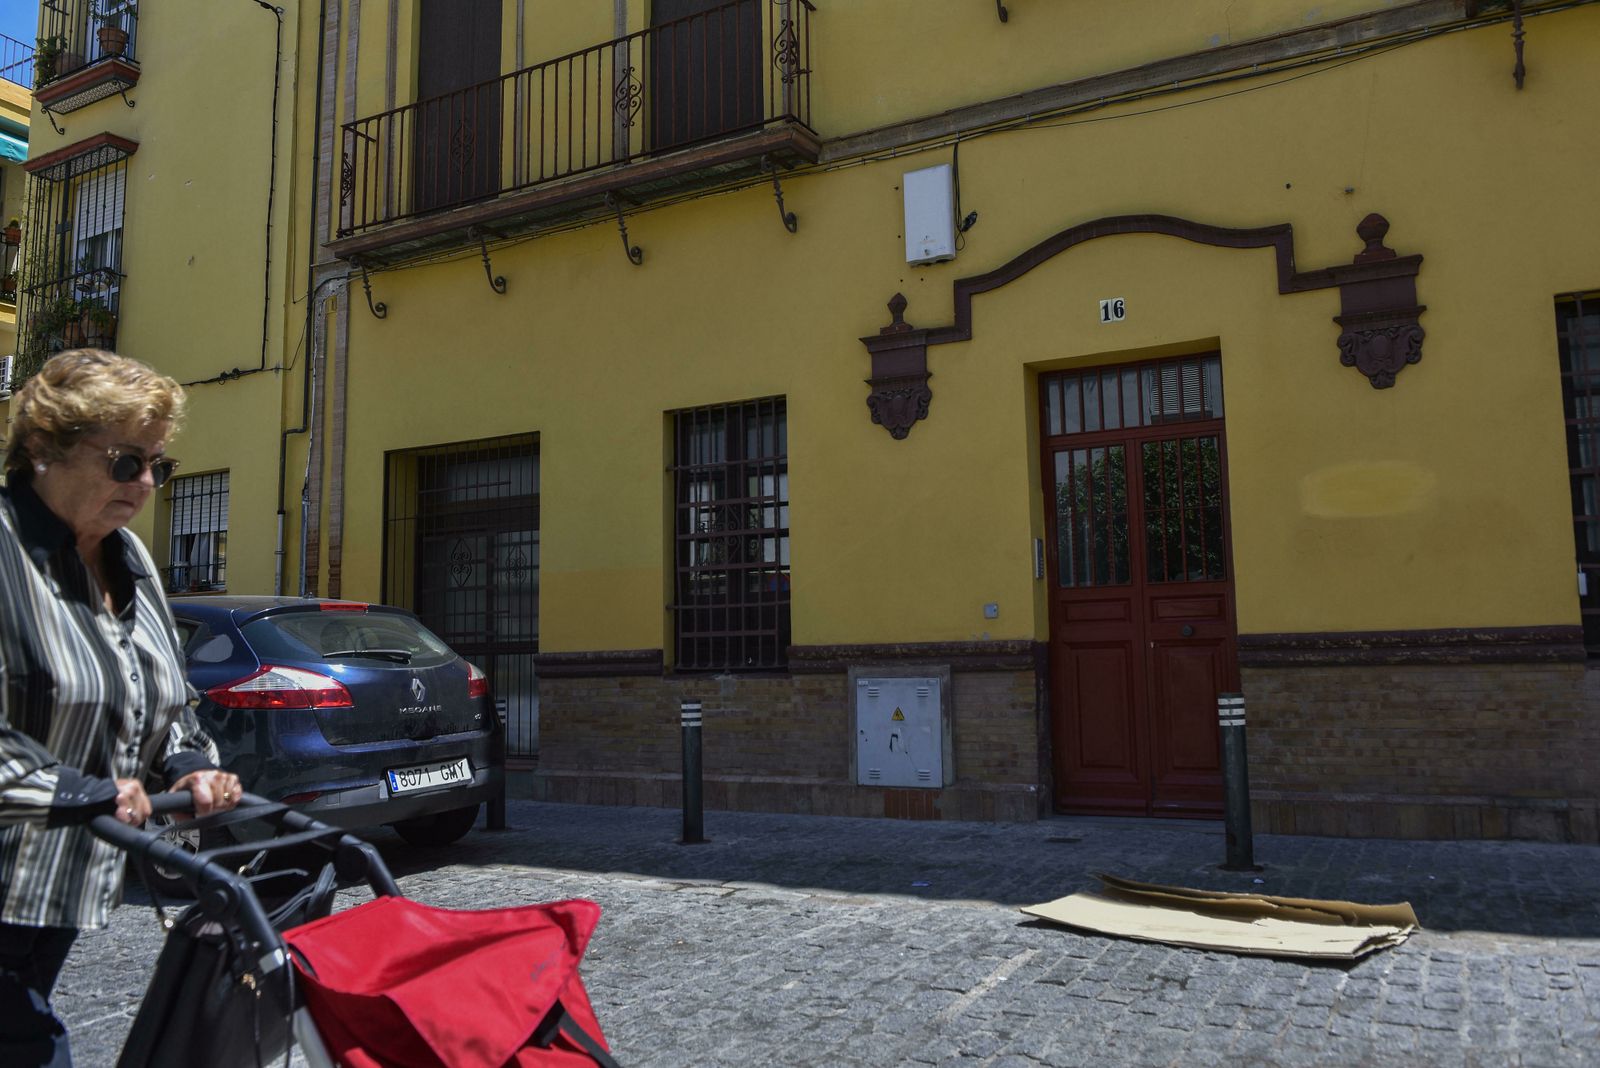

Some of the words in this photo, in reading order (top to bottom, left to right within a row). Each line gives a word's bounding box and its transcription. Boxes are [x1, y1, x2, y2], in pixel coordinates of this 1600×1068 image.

[1102, 299, 1125, 322] 16
[399, 767, 432, 787] 8071
[440, 762, 465, 781] GMY
